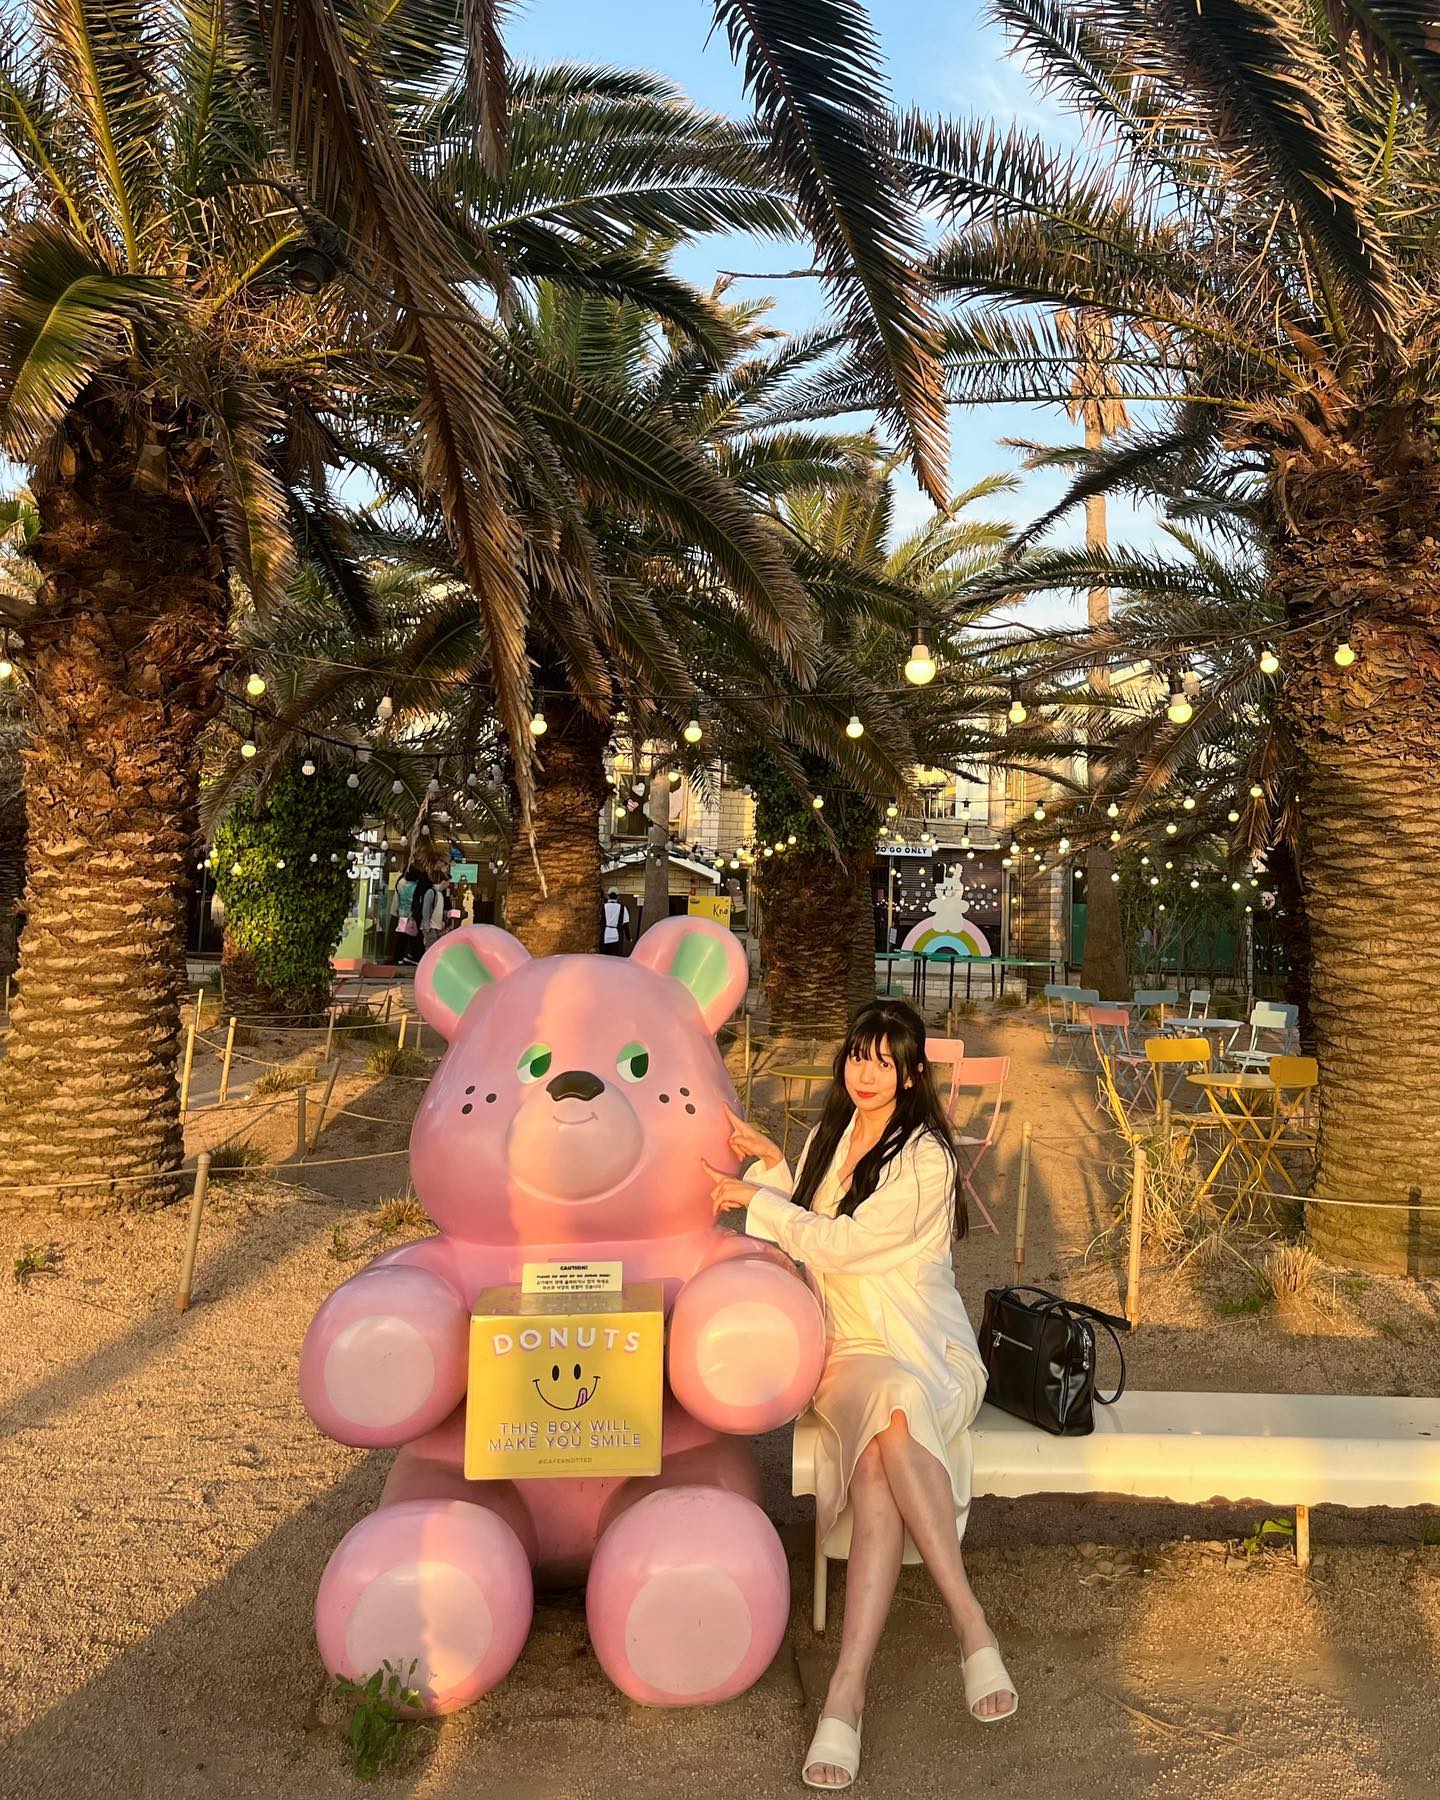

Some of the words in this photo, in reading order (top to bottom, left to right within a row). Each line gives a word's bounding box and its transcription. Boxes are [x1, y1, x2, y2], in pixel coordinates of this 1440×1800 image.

[493, 1327, 640, 1355] DONUTS
[500, 1421, 539, 1435] THIS
[548, 1420, 582, 1433] BOX
[590, 1419, 631, 1432] WILL
[488, 1436, 537, 1451] MAKE
[545, 1435, 582, 1448] YOU
[590, 1433, 641, 1448] SMILE
